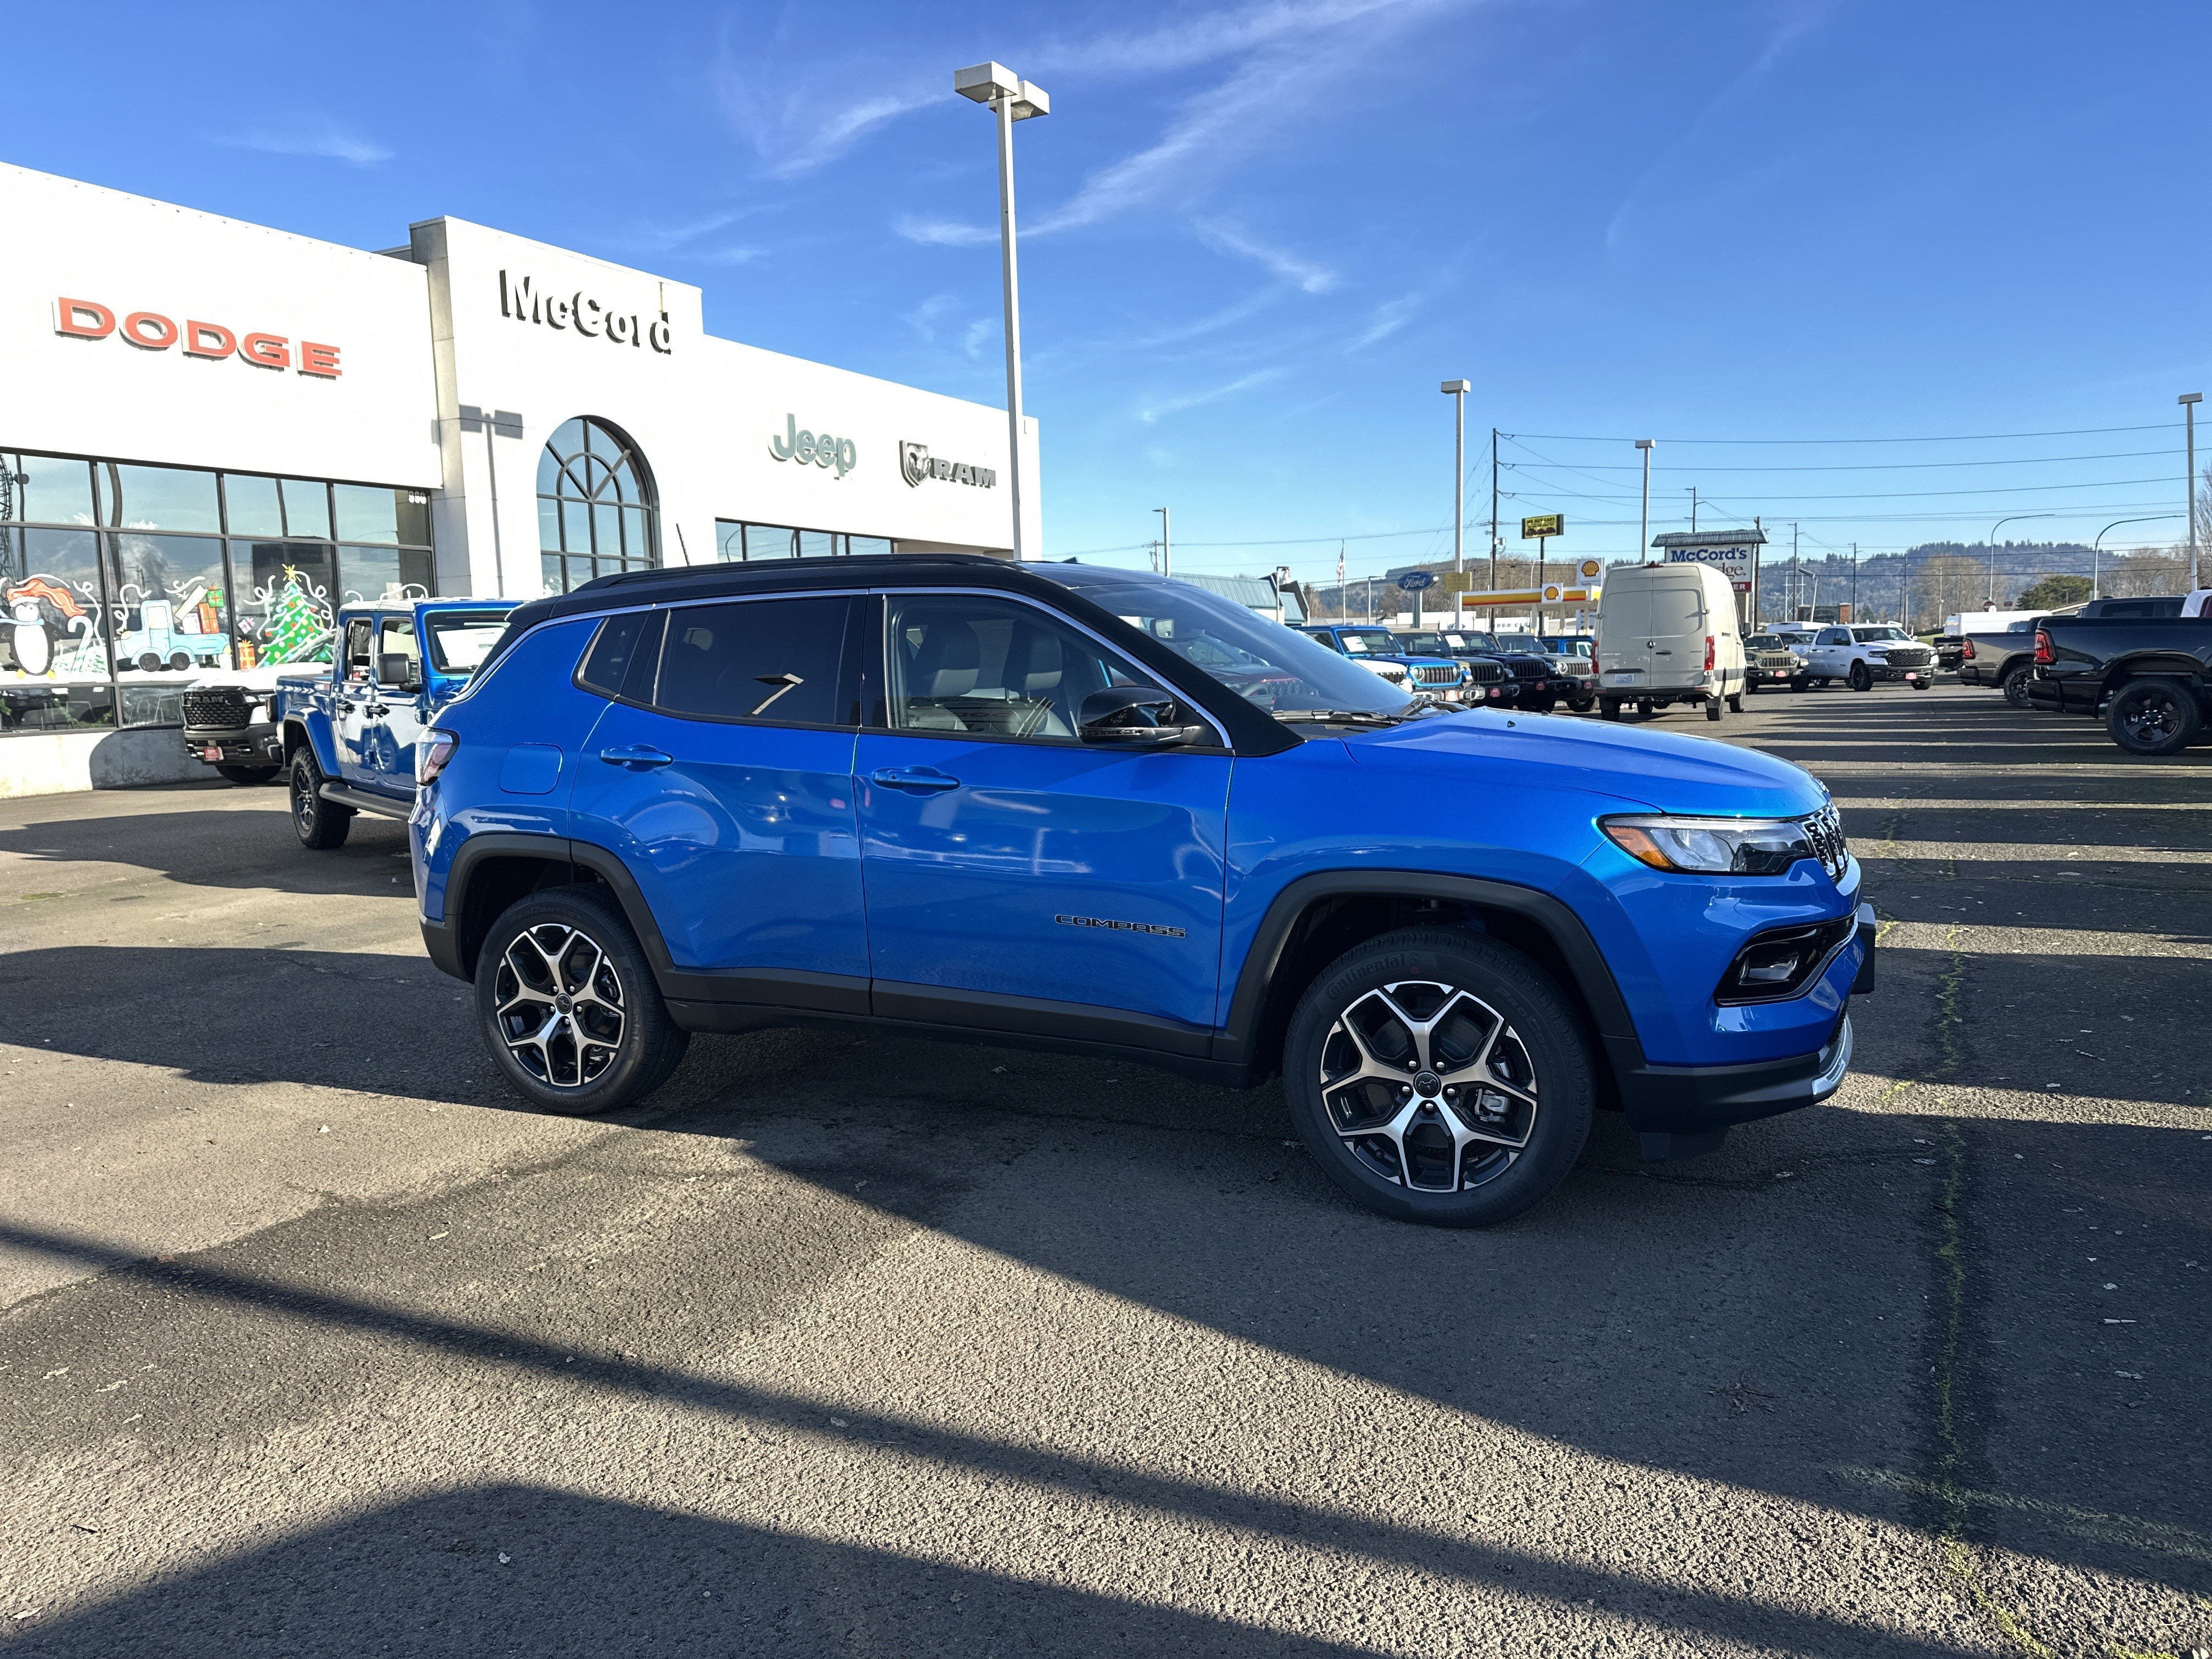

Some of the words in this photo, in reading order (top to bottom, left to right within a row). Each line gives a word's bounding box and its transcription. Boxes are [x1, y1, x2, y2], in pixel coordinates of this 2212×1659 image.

[499, 268, 672, 355] McCord
[52, 296, 342, 380] DODGE
[769, 413, 856, 479] Jeep
[930, 457, 996, 488] RAM
[1671, 548, 1747, 562] McCord's
[1403, 575, 1426, 590] Ford
[1717, 562, 1747, 580] dge.
[1054, 914, 1187, 938] COMPASS
[1325, 953, 1406, 1000] Continental
